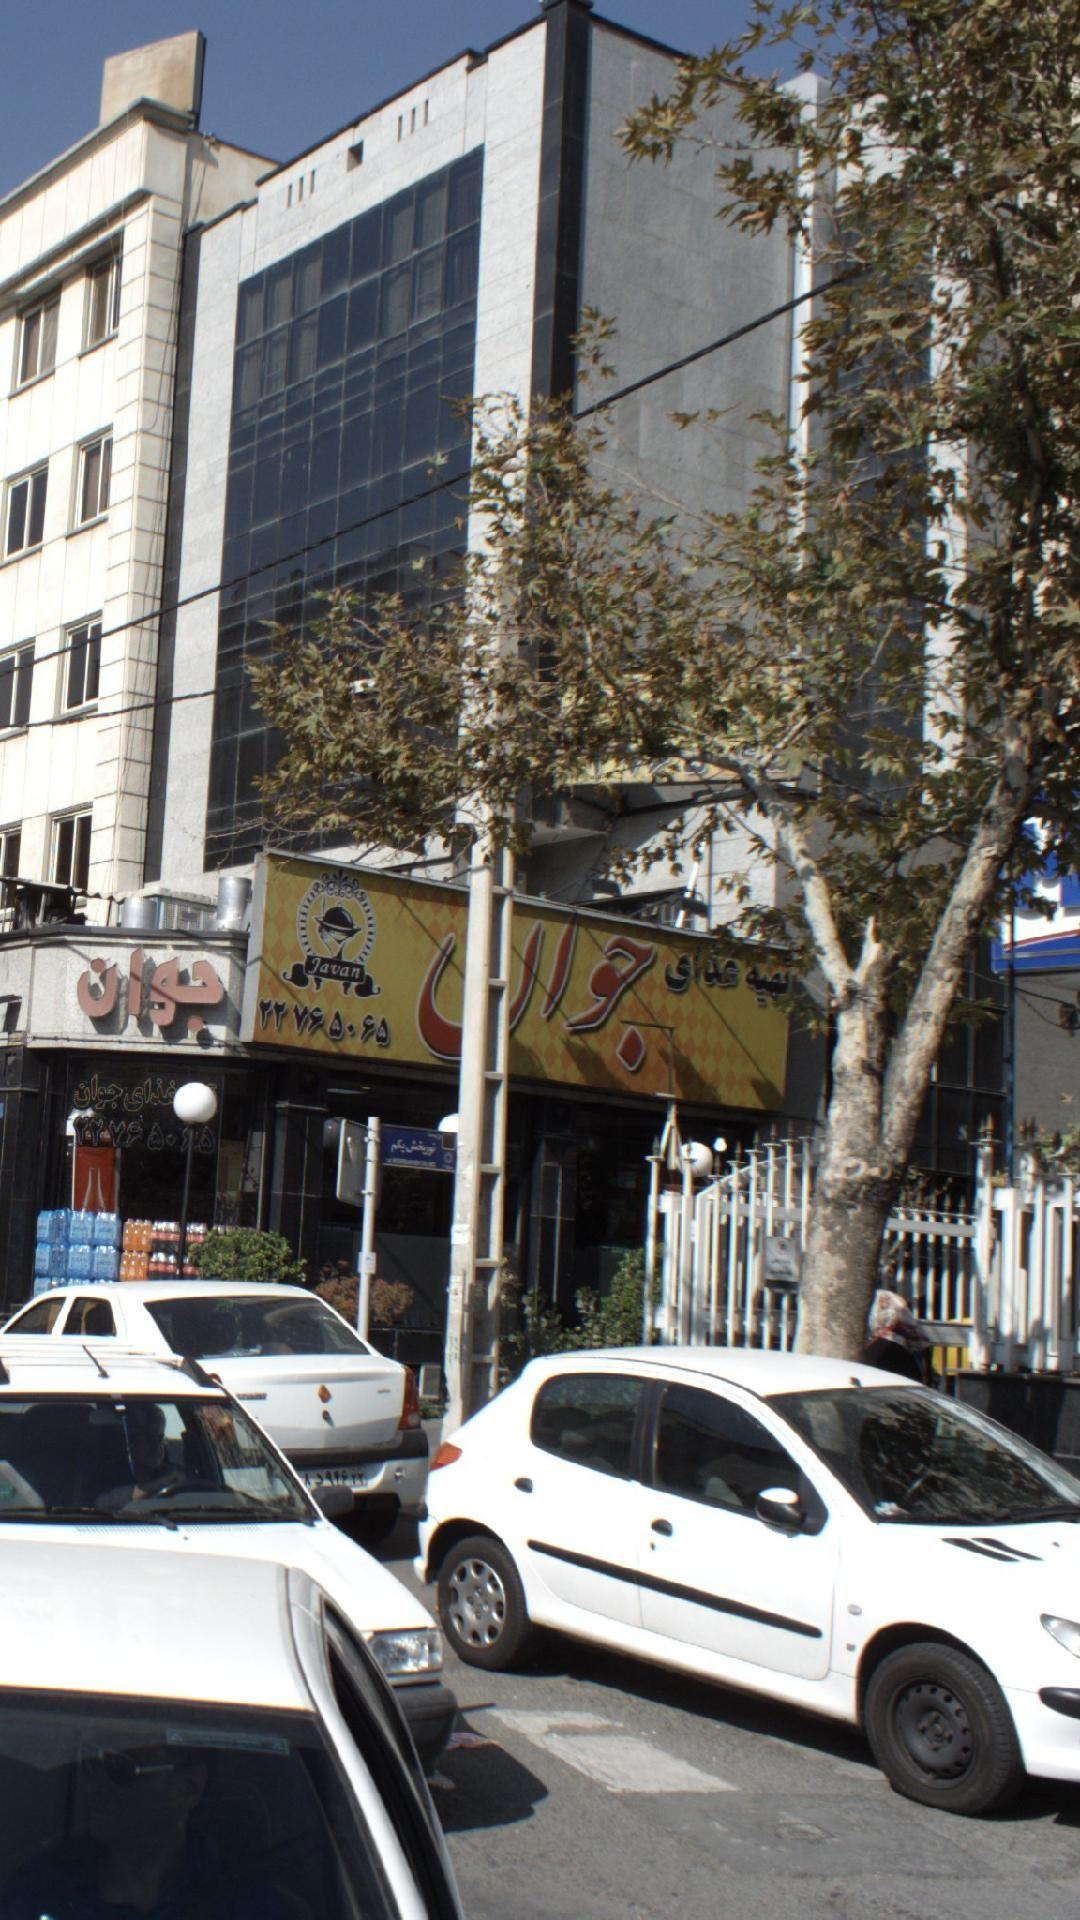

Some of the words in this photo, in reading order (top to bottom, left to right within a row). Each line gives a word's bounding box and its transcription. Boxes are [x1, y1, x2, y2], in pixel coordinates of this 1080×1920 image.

[77, 947, 224, 1032] جوان
[308, 957, 362, 979] Javan
[417, 911, 656, 1071] جوان
[73, 1073, 124, 1110] جوان
